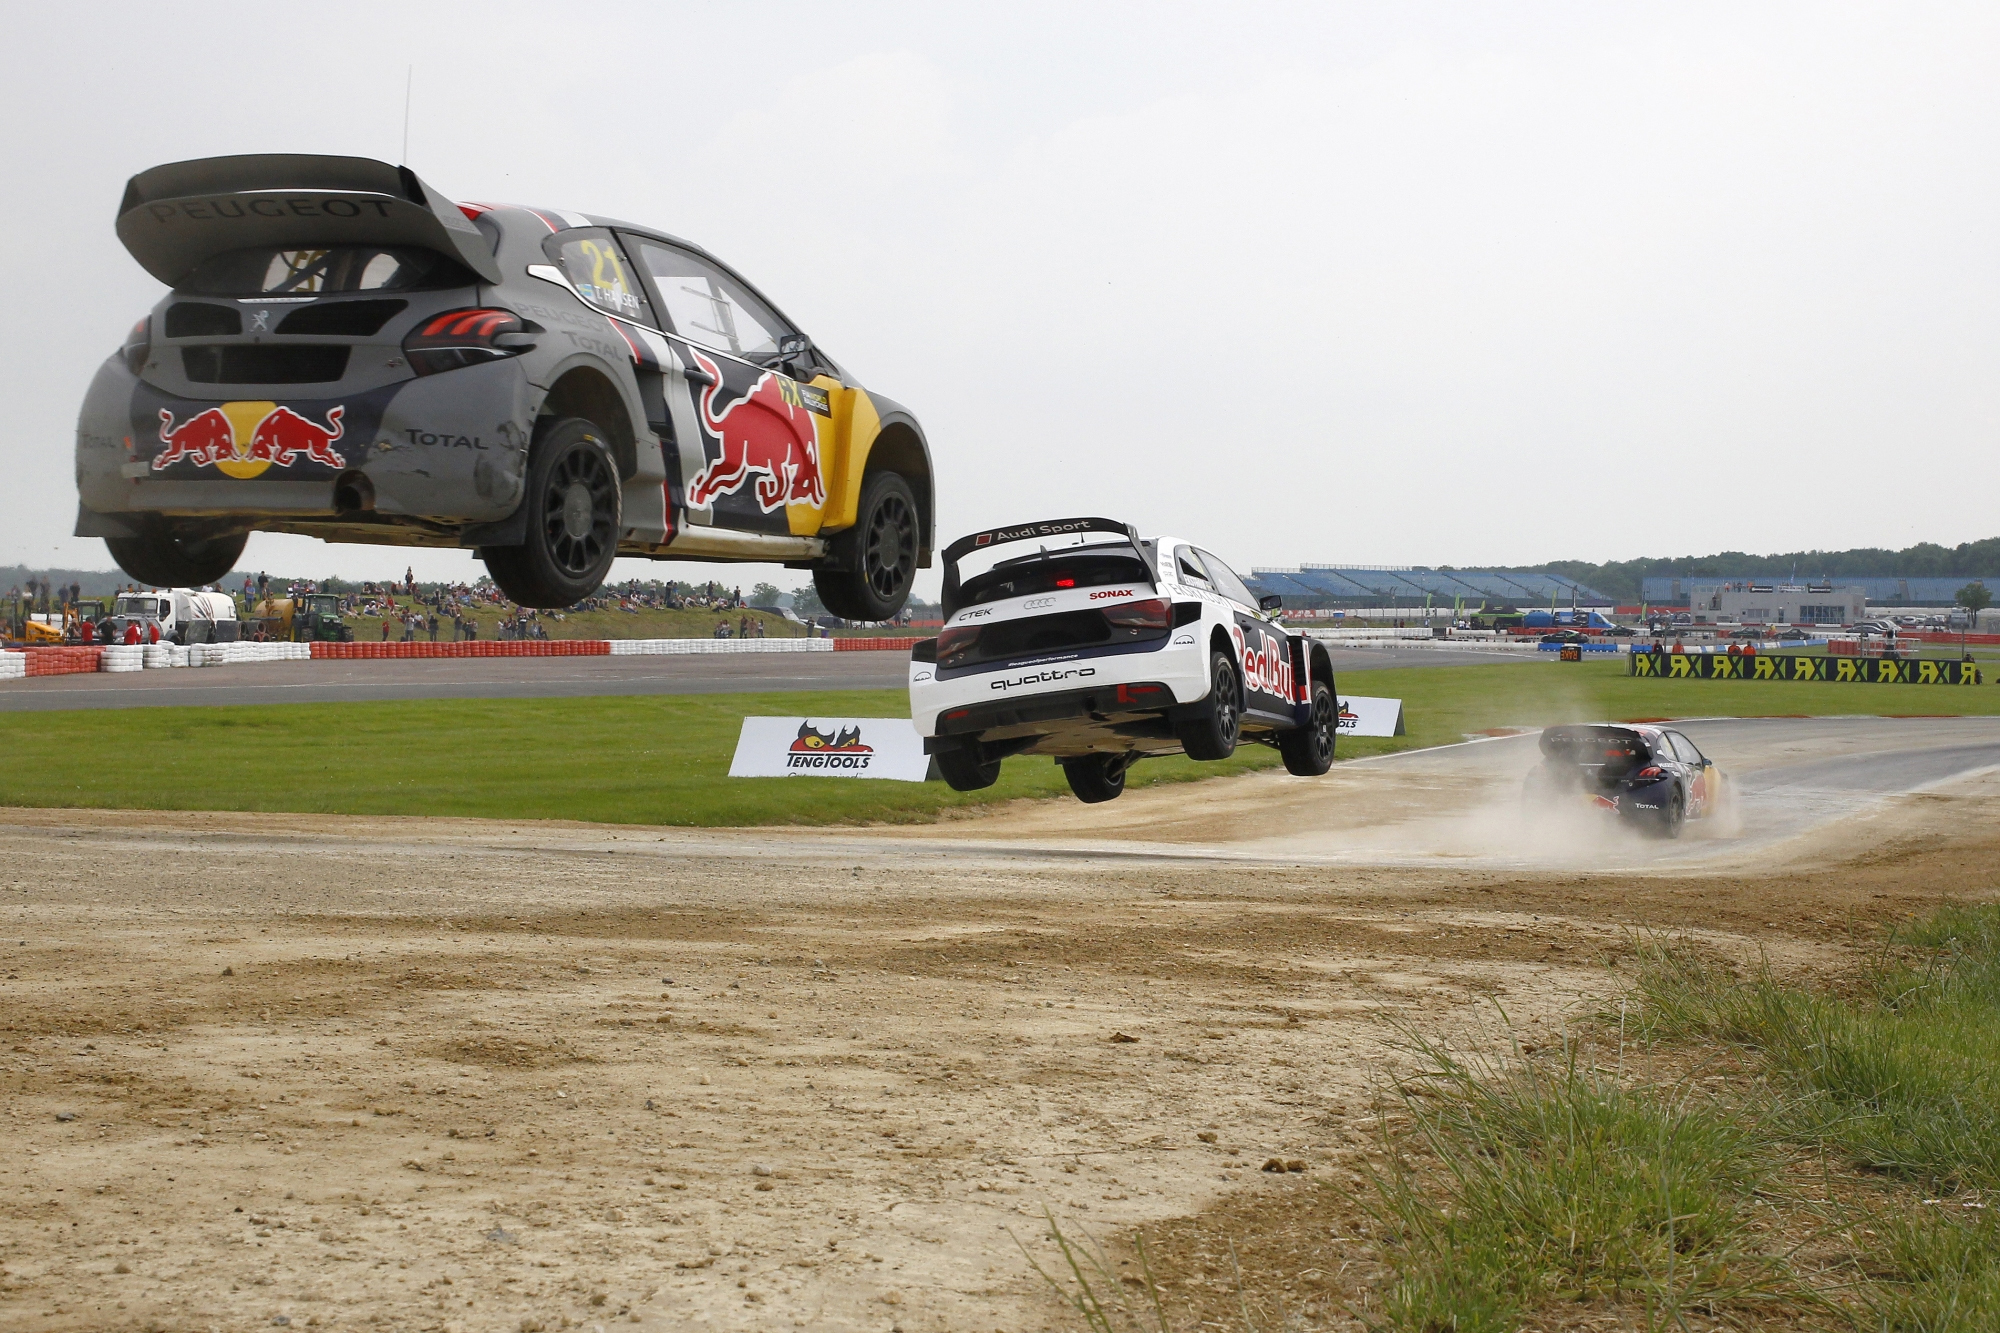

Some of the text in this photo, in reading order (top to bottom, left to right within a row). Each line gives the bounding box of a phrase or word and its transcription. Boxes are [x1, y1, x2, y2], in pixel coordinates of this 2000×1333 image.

[150, 199, 392, 223] PEUGEOT
[581, 240, 629, 294] 21
[603, 288, 640, 309] HASEN
[513, 302, 613, 334] PEUGEOT
[561, 330, 623, 362] TOTAL
[405, 428, 489, 450] TOTAL
[997, 520, 1091, 541] Audi Sport
[1089, 589, 1133, 600] SONAX
[959, 608, 993, 621] CTEK
[990, 668, 1096, 690] quattro
[1550, 737, 1632, 745] PEUGEOT
